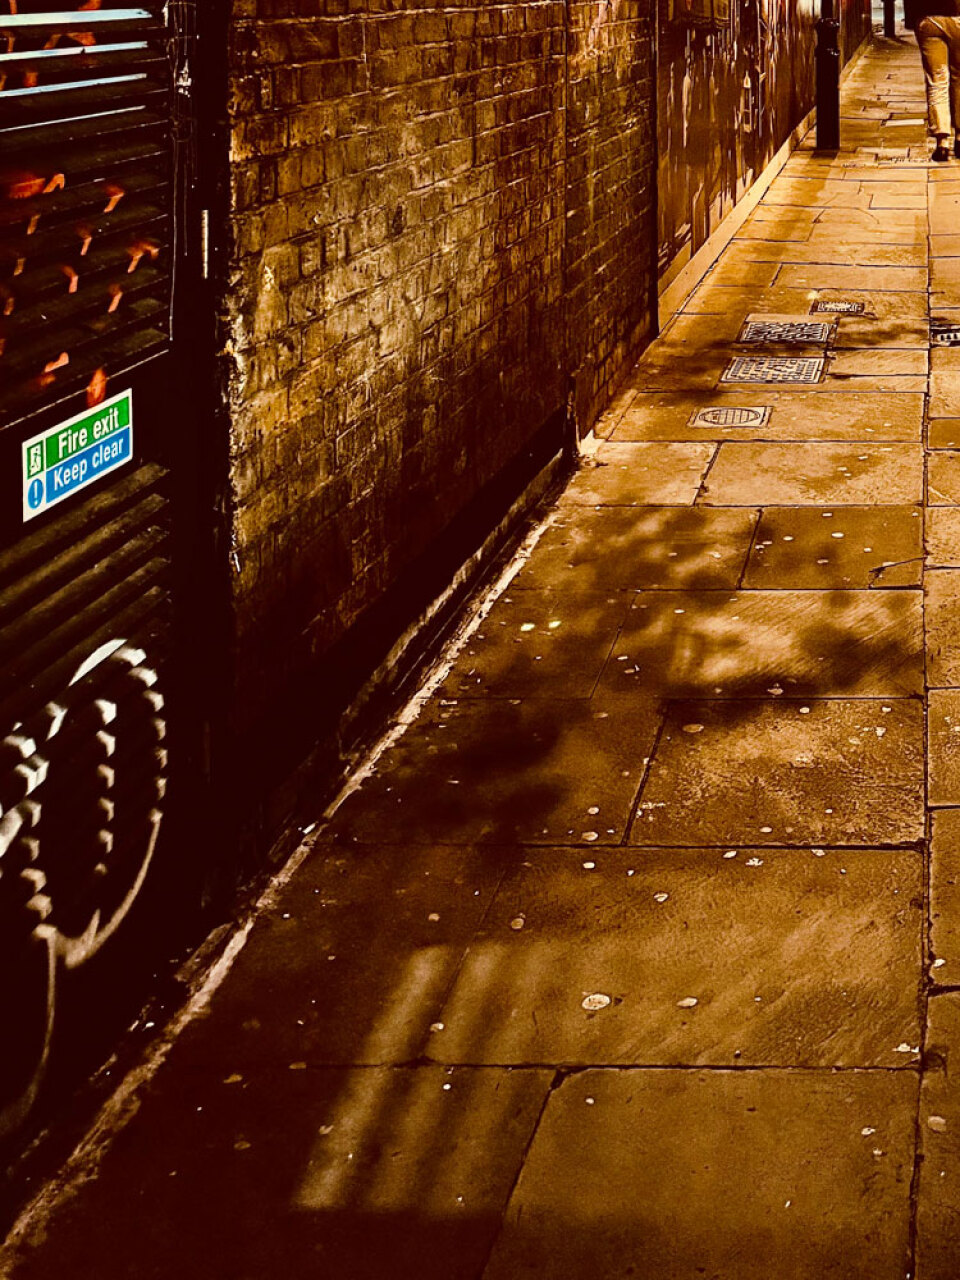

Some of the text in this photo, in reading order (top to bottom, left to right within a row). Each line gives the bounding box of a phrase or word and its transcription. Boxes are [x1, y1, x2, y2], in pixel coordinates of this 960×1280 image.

[58, 407, 120, 459] Fire exit
[54, 437, 124, 491] Keep clear
